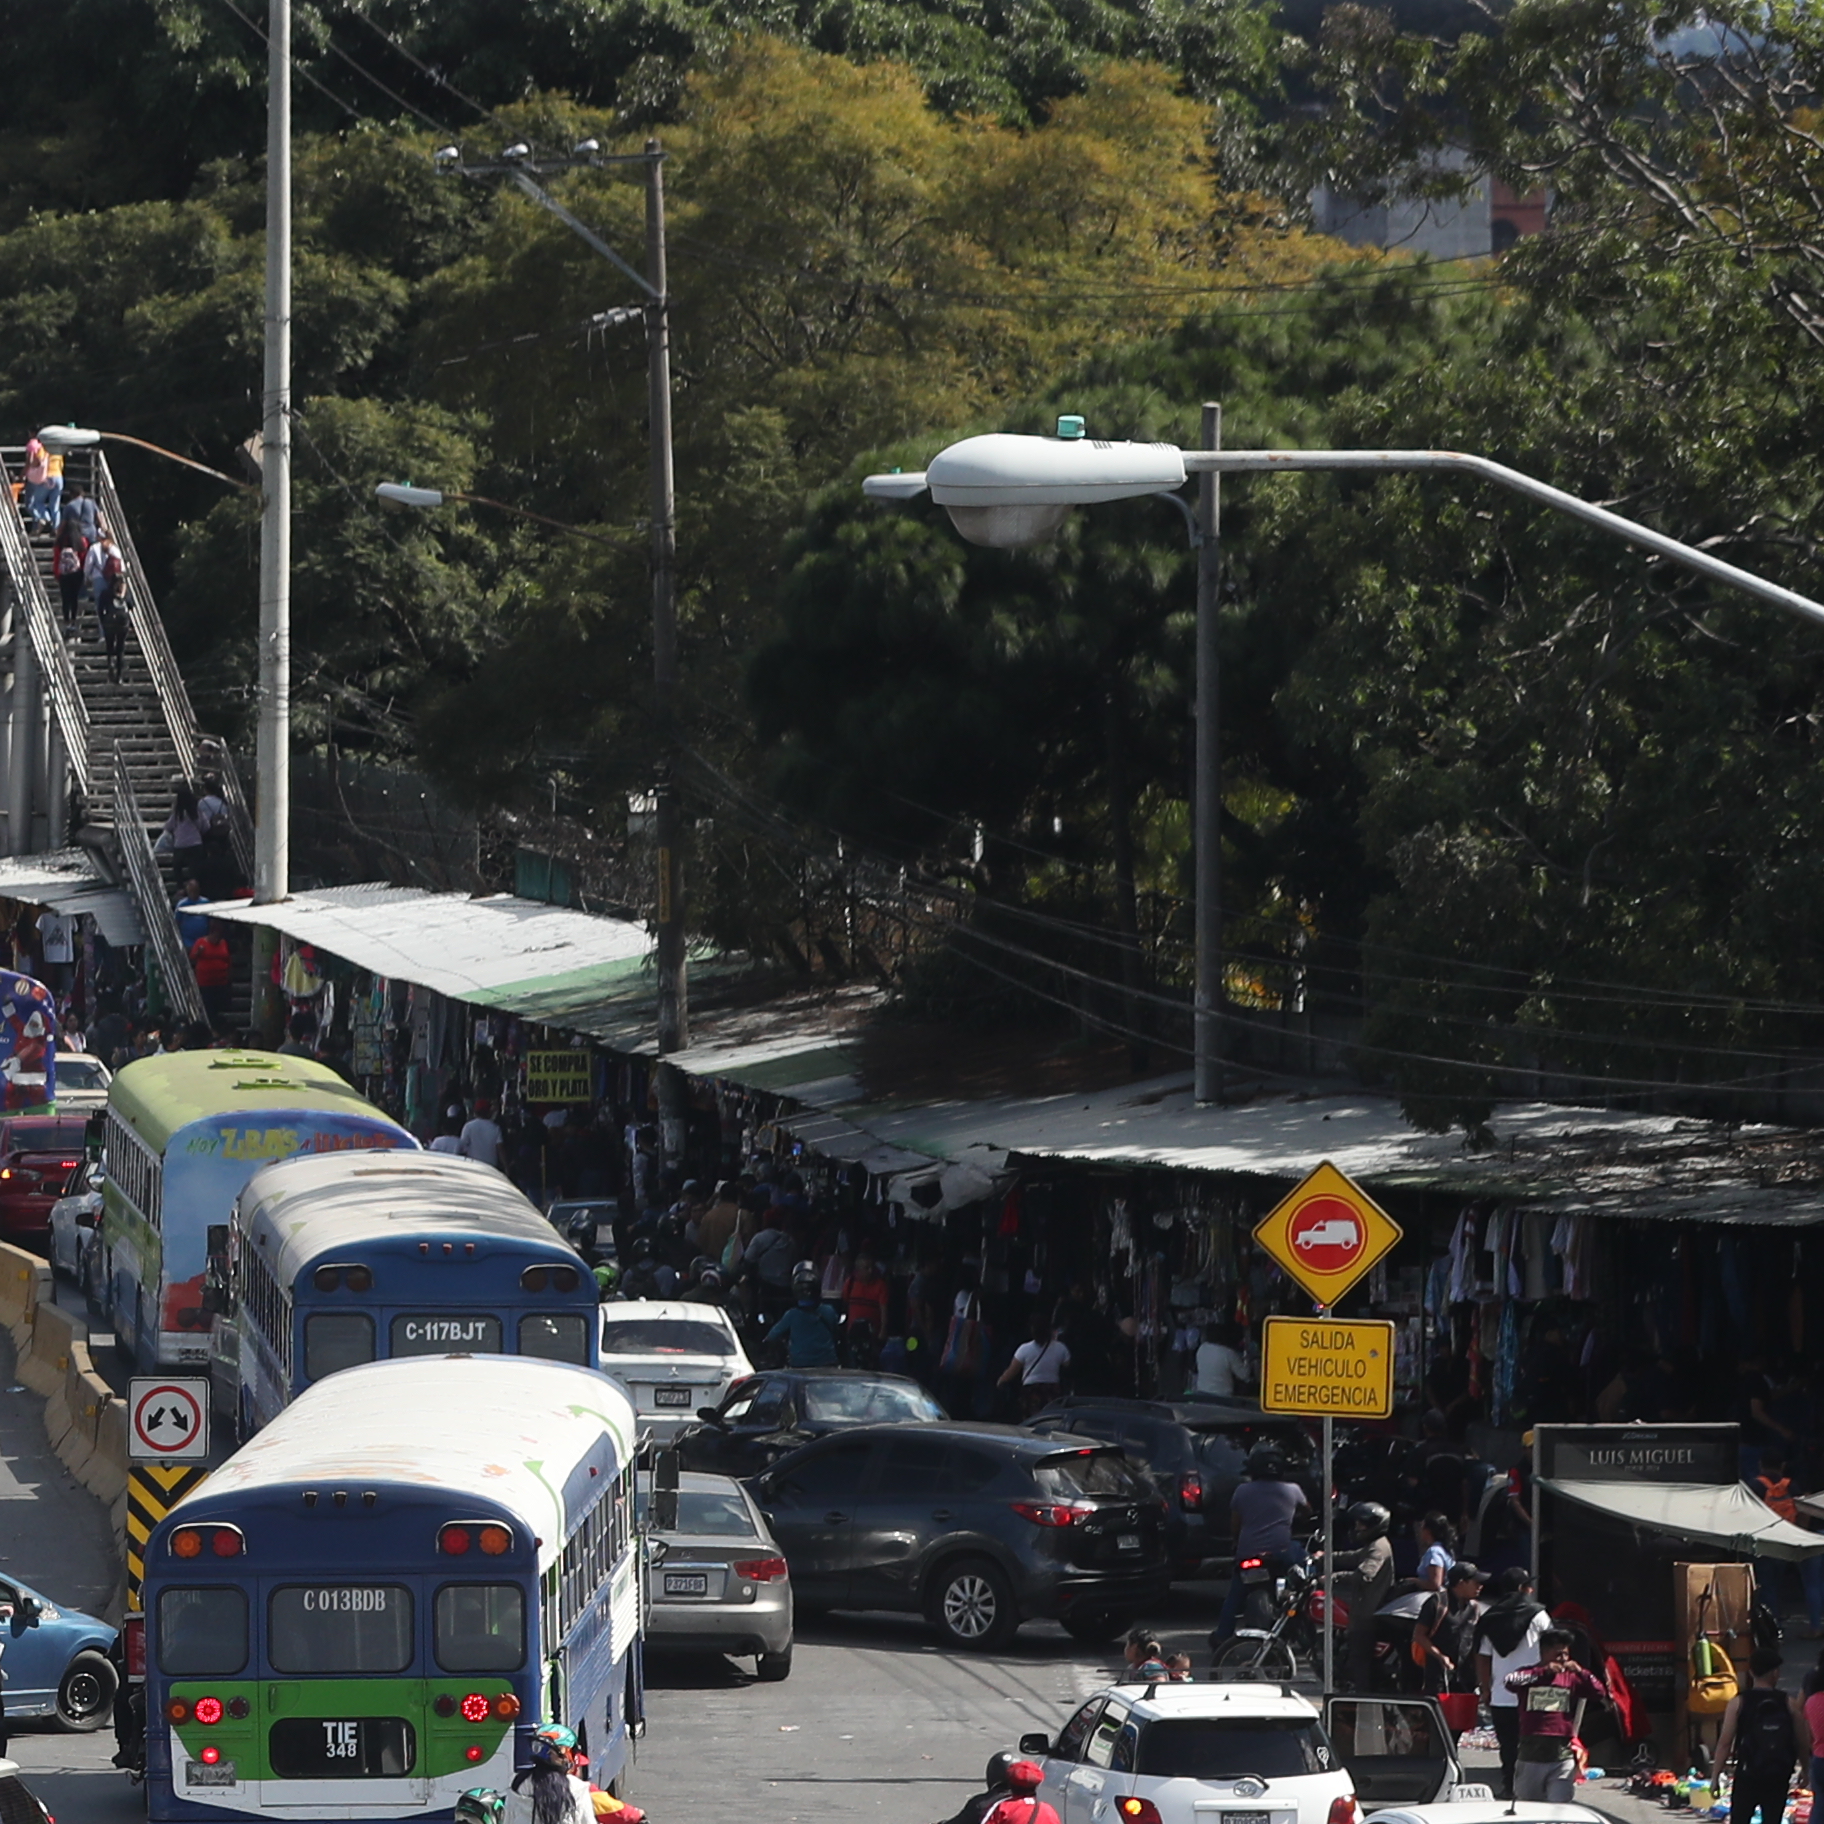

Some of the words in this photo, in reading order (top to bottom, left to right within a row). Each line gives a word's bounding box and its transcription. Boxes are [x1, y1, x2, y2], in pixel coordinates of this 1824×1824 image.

[529, 1054, 543, 1072] SE
[544, 1054, 588, 1072] COMPRA
[528, 1078, 549, 1098] ORO
[550, 1079, 558, 1097] Y
[560, 1079, 590, 1098] PLATA
[405, 1321, 486, 1341] C-117BJT
[1299, 1329, 1356, 1352] SALIDA
[1286, 1356, 1367, 1381] VEHICULO
[1272, 1384, 1379, 1408] EMERGENCIA
[1589, 1450, 1626, 1466] LUIS
[1629, 1449, 1696, 1466] MIGUEL
[319, 1590, 386, 1612] 013BDB
[322, 1721, 358, 1743] TIE
[325, 1743, 357, 1758] 348
[1459, 1788, 1486, 1799] TAXI
